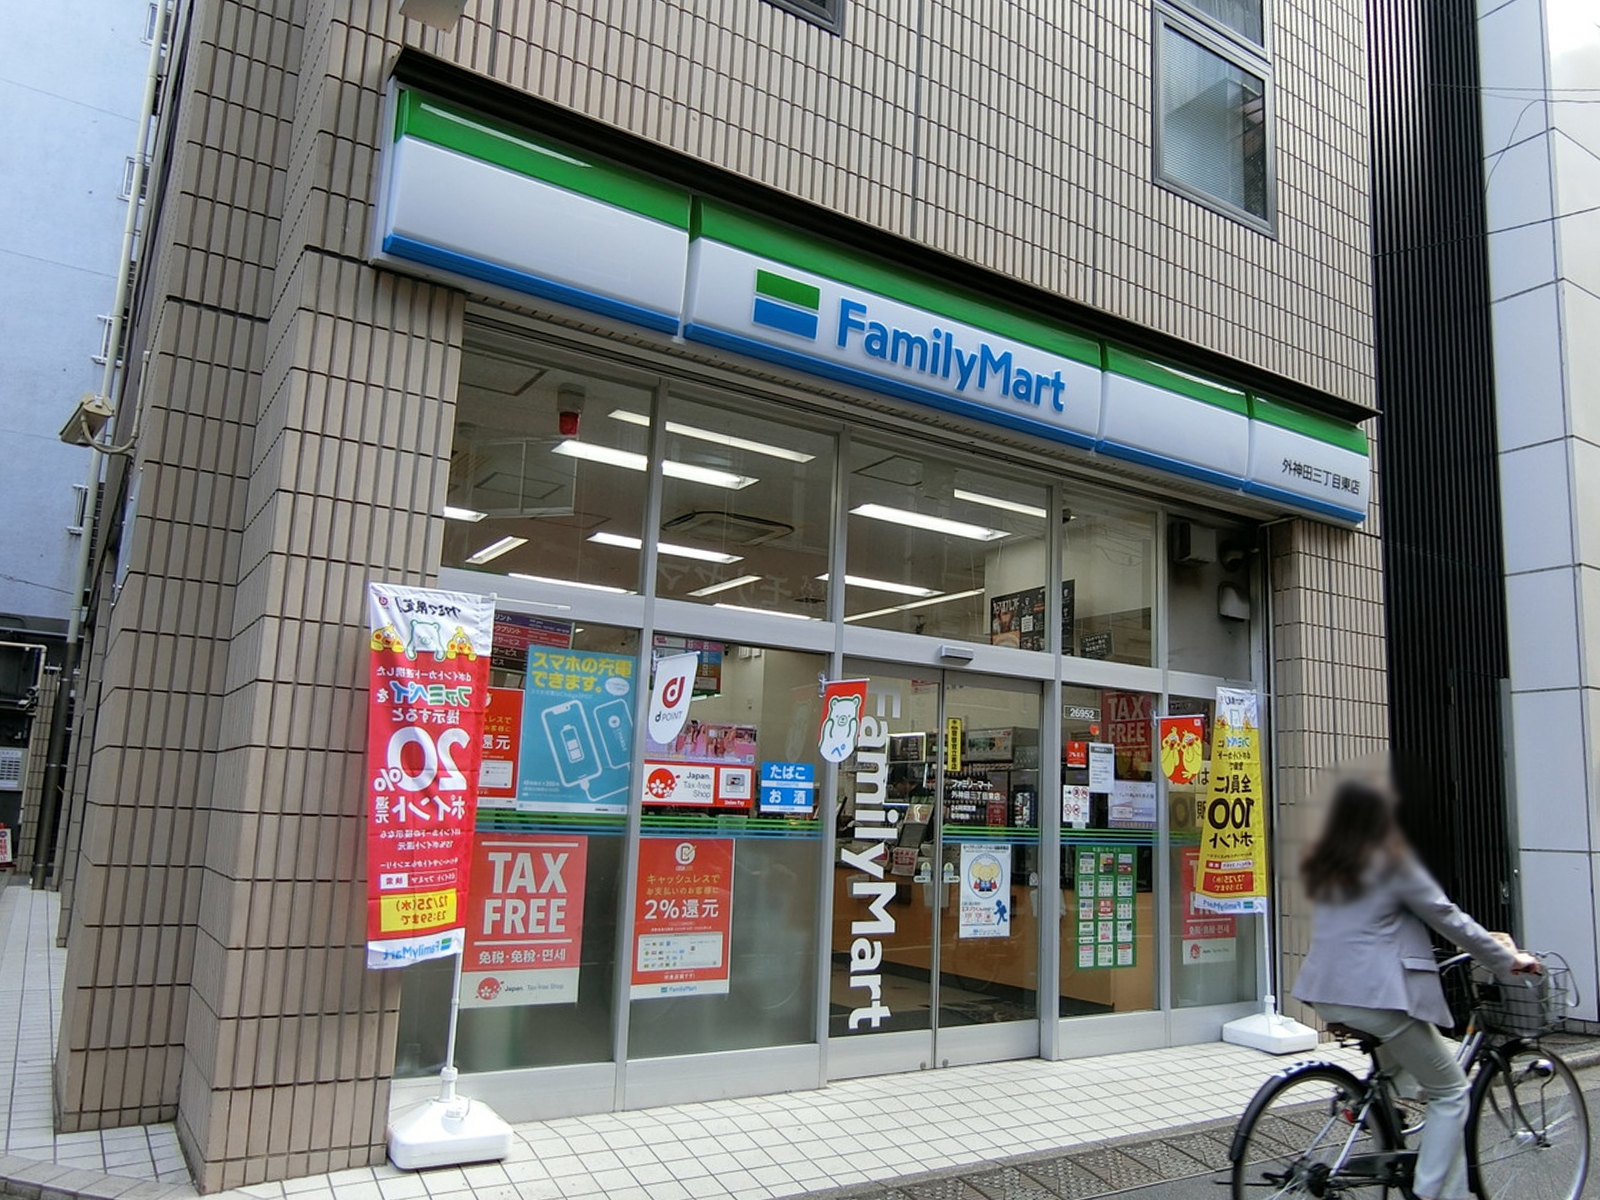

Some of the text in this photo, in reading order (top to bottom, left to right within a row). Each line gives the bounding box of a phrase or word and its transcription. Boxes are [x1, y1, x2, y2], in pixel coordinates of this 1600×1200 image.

[836, 297, 1066, 413] FamilyMart
[1281, 458, 1360, 495] 外神田三丁目東店
[532, 652, 632, 678] スマホの充電
[532, 671, 602, 693] できます。
[662, 711, 682, 722] POINT
[1070, 707, 1095, 719] 26952
[1107, 696, 1145, 721] TAX
[485, 716, 512, 725] レスで
[1107, 722, 1146, 744] FREE
[769, 764, 806, 780] たばこ
[693, 789, 711, 799] Shop
[951, 779, 993, 790] ファミリーマート
[841, 680, 902, 1030] FamilyMart
[488, 852, 569, 894] TAX
[647, 874, 720, 885] キャッシュレスで
[646, 886, 720, 896] お支払いのお客様に
[483, 898, 567, 935] FREE
[644, 899, 719, 920] 2%還元
